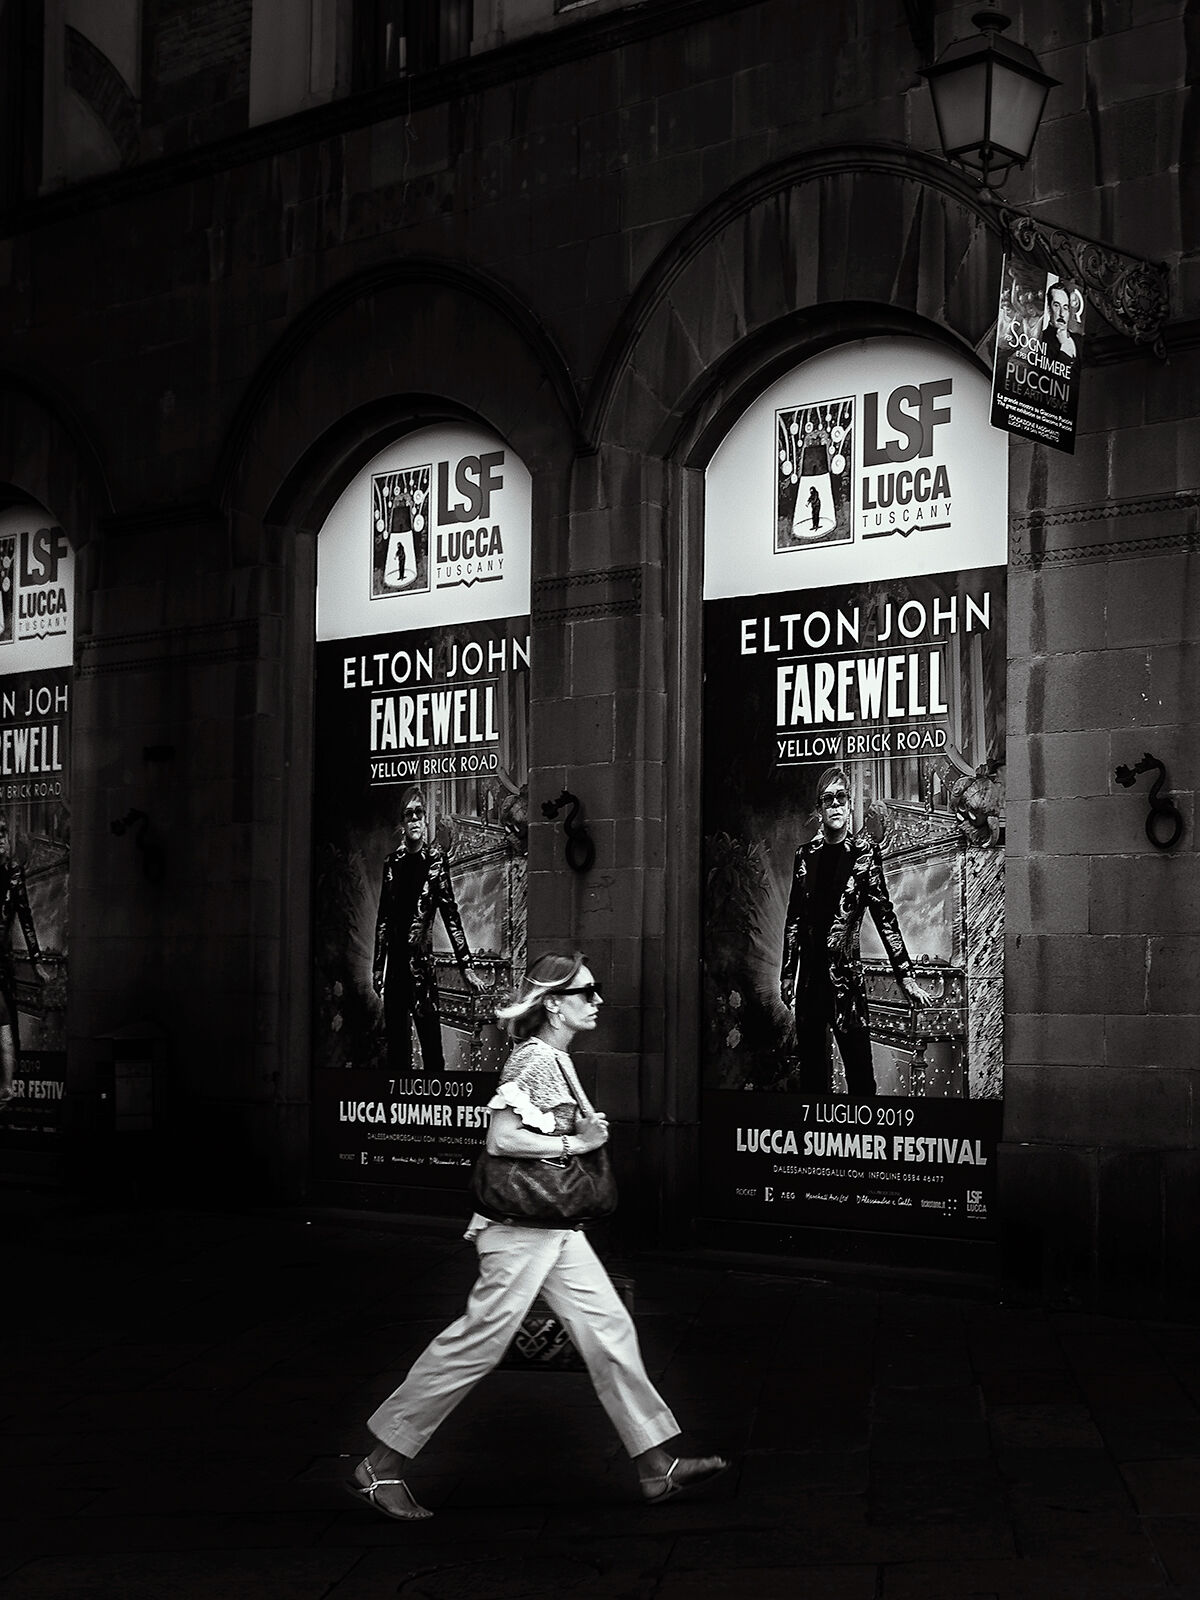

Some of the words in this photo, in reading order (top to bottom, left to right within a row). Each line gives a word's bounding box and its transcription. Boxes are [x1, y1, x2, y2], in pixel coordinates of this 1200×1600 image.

[1028, 351, 1072, 380] CHIMERE
[1006, 362, 1070, 402] PUCCINI
[1012, 382, 1022, 395] LE
[862, 378, 952, 468] LSF
[437, 451, 505, 526] LSF
[862, 465, 951, 510] LUCCA
[862, 503, 952, 527] TUSCANY
[20, 526, 68, 588] LSF
[437, 525, 503, 564] LUCCA
[437, 559, 504, 579] TUSCANY
[19, 588, 67, 619] LUCCA
[19, 615, 67, 633] TUSCANY
[740, 607, 859, 655] ELTON
[878, 592, 990, 641] JOHN
[344, 648, 433, 689] ELTON
[447, 636, 531, 677] JOHN
[25, 685, 68, 717] JOH
[777, 651, 947, 726] FAREWELL
[370, 686, 499, 751] FAREWELL
[0, 725, 62, 775] EWELL
[777, 737, 841, 759] YELLOW
[847, 732, 891, 753] BRICK
[898, 729, 947, 749] ROAD
[371, 759, 420, 779] YELLOW
[424, 756, 456, 775] BRICK
[461, 753, 498, 771] ROAD
[7, 784, 31, 799] BRICK
[35, 782, 61, 798] ROAD
[29, 1080, 64, 1100] FESTIV
[389, 1080, 395, 1095] 7
[400, 1079, 442, 1097] LUGLIO
[445, 1082, 473, 1097] 2019
[339, 1101, 386, 1124] LUCCA
[391, 1103, 452, 1127] SUMMER
[457, 1105, 491, 1128] FEST
[802, 1105, 809, 1122] 7
[816, 1103, 872, 1126] LUGLIO
[877, 1107, 914, 1127] 2019
[736, 1128, 798, 1155] LUCCA
[804, 1131, 887, 1160] SUMMER
[893, 1135, 987, 1165] FESTIVAL
